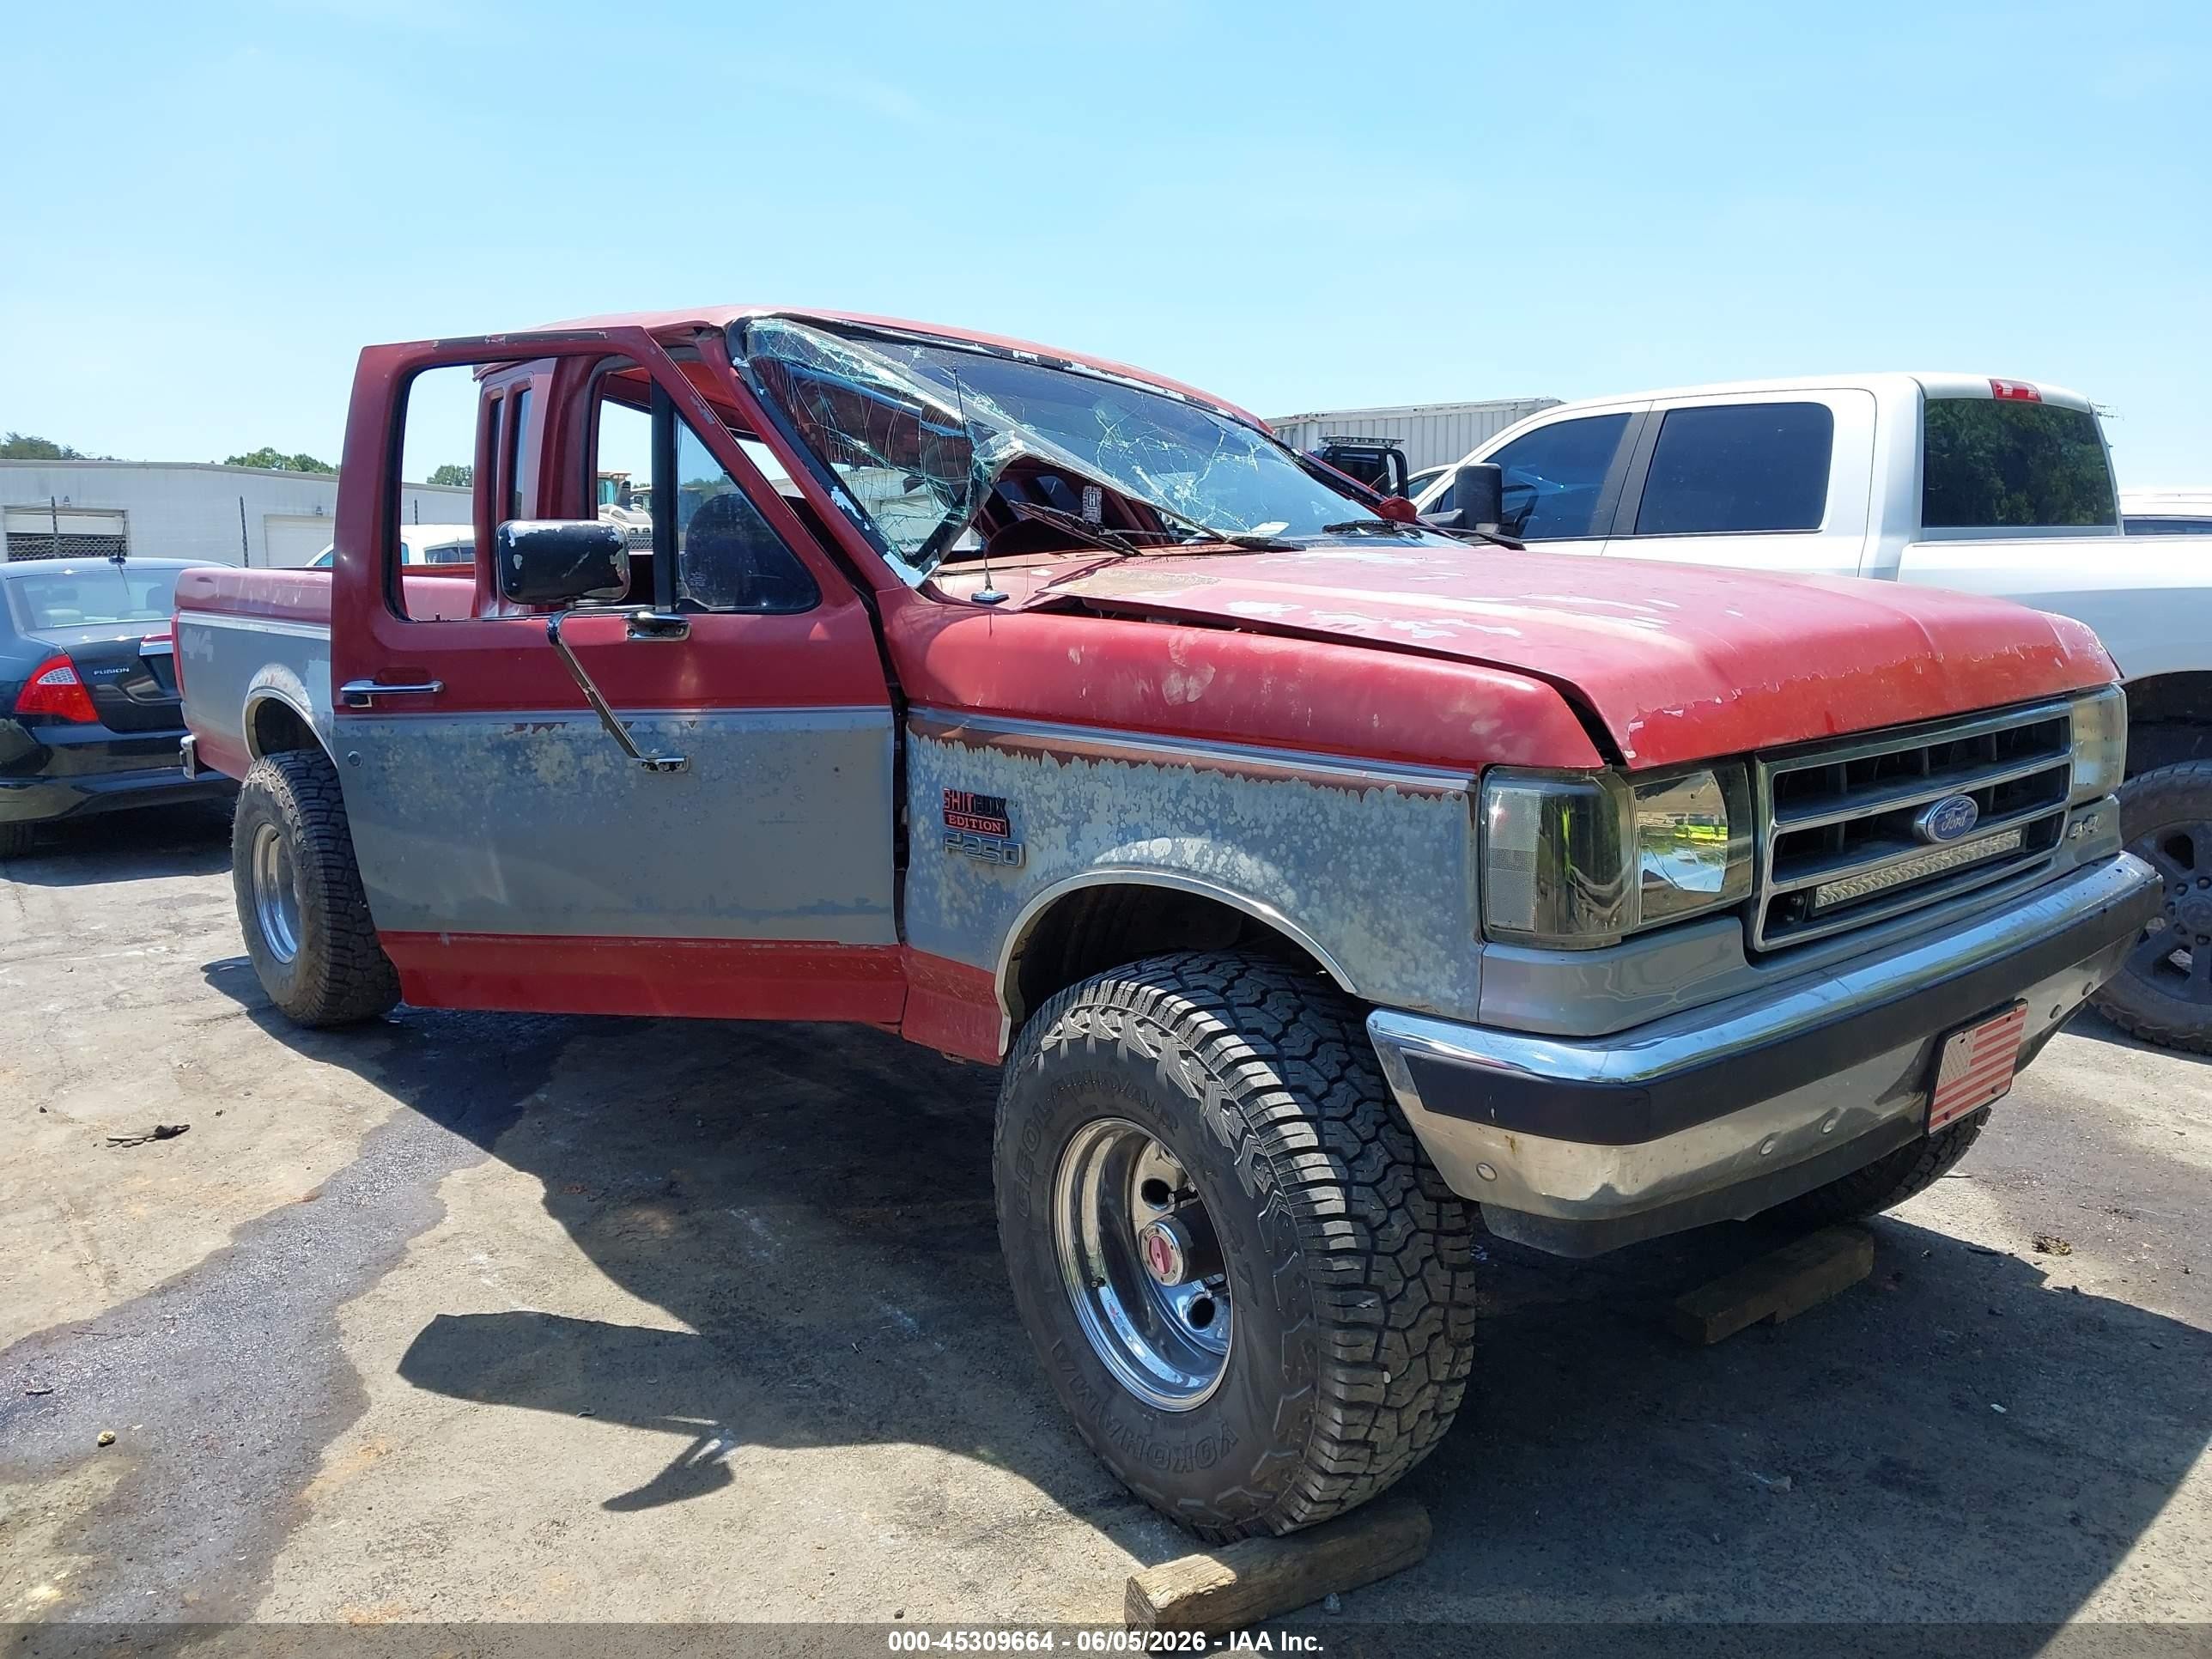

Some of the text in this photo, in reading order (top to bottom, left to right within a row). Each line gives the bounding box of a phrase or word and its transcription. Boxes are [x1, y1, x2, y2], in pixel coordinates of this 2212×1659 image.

[93, 667, 130, 676] FUSION
[948, 814, 1001, 832] EDITION
[1941, 810, 1968, 832] Ford
[1051, 1337, 1239, 1473] YOKOHAMA
